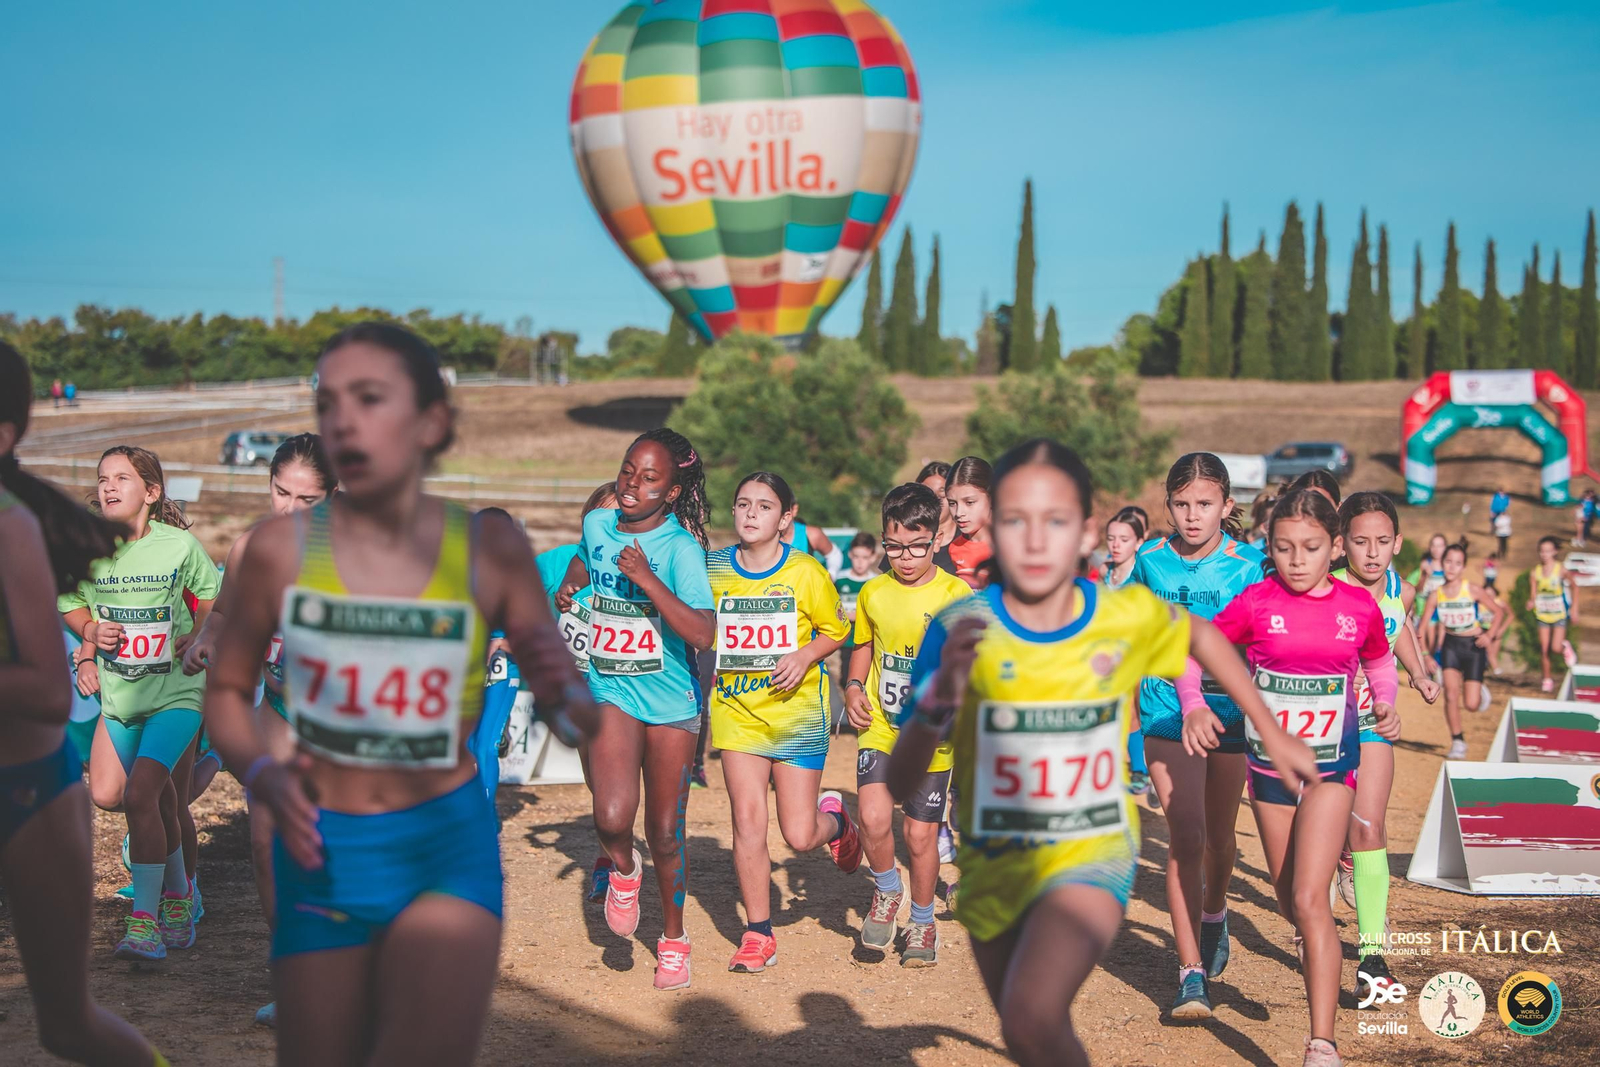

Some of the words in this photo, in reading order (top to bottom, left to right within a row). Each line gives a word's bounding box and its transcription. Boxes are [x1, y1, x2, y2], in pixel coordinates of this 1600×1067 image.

[675, 109, 733, 143] Hay
[744, 107, 804, 136] otra
[652, 138, 837, 201] Sevilla.
[122, 574, 169, 584] CASTILLO
[112, 608, 151, 619] ITÁLICA
[563, 622, 590, 656] 56
[592, 623, 657, 654] 7224
[725, 624, 792, 650] 5201
[298, 657, 451, 719] 7148
[1275, 677, 1322, 691] ITÁLICA
[991, 749, 1116, 800] 5170
